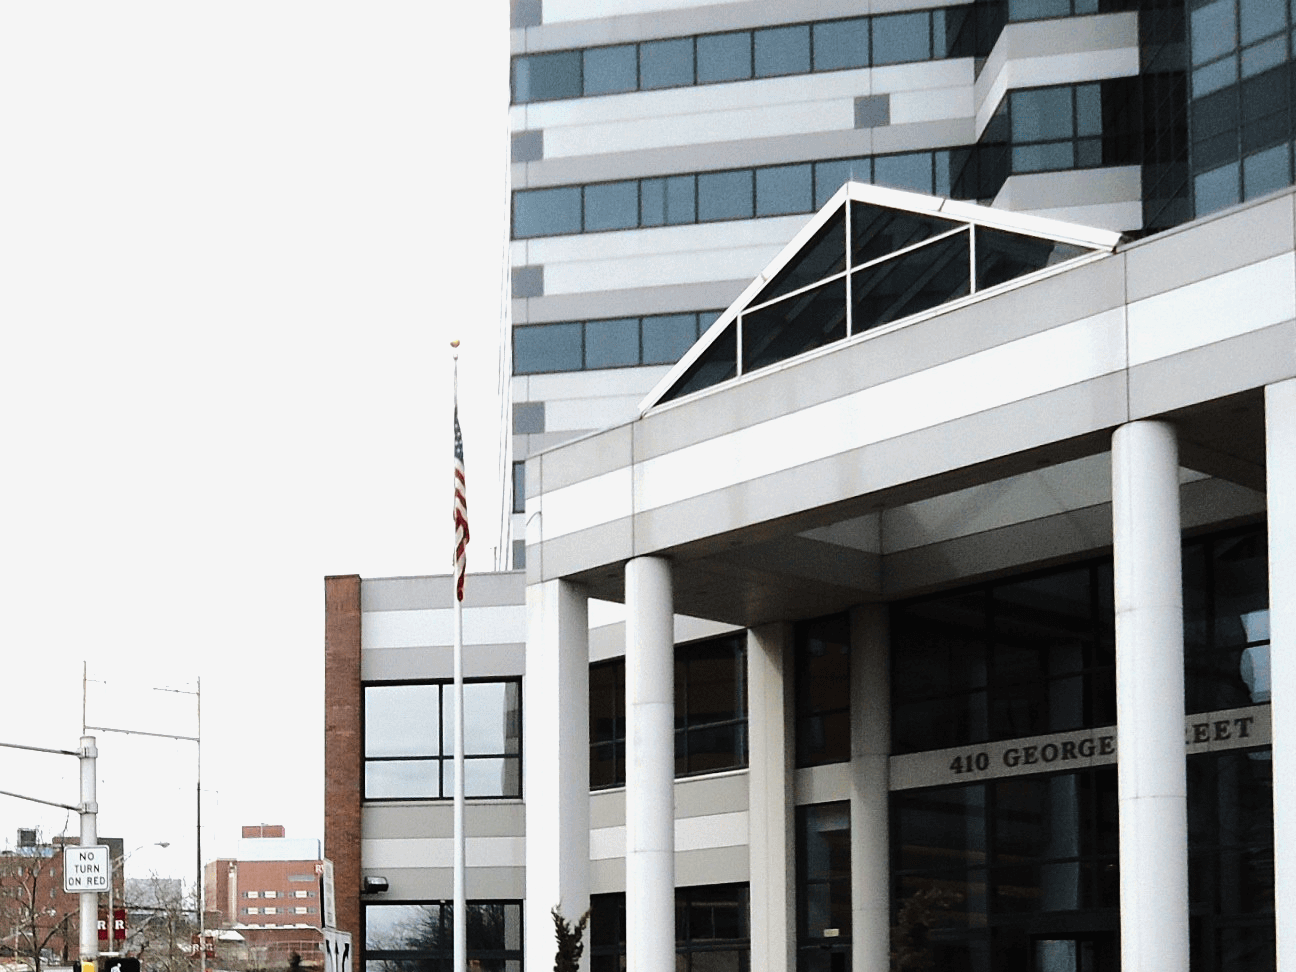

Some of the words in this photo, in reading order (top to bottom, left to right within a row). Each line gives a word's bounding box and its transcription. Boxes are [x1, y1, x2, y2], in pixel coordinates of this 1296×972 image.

[950, 752, 990, 774] 410
[1002, 736, 1116, 768] GEORGE
[1185, 717, 1254, 744] EET
[79, 852, 95, 861] NO
[74, 864, 100, 873] TURN
[68, 876, 82, 886] ON
[86, 876, 106, 886] RED
[97, 920, 106, 930] R
[115, 920, 124, 930] R
